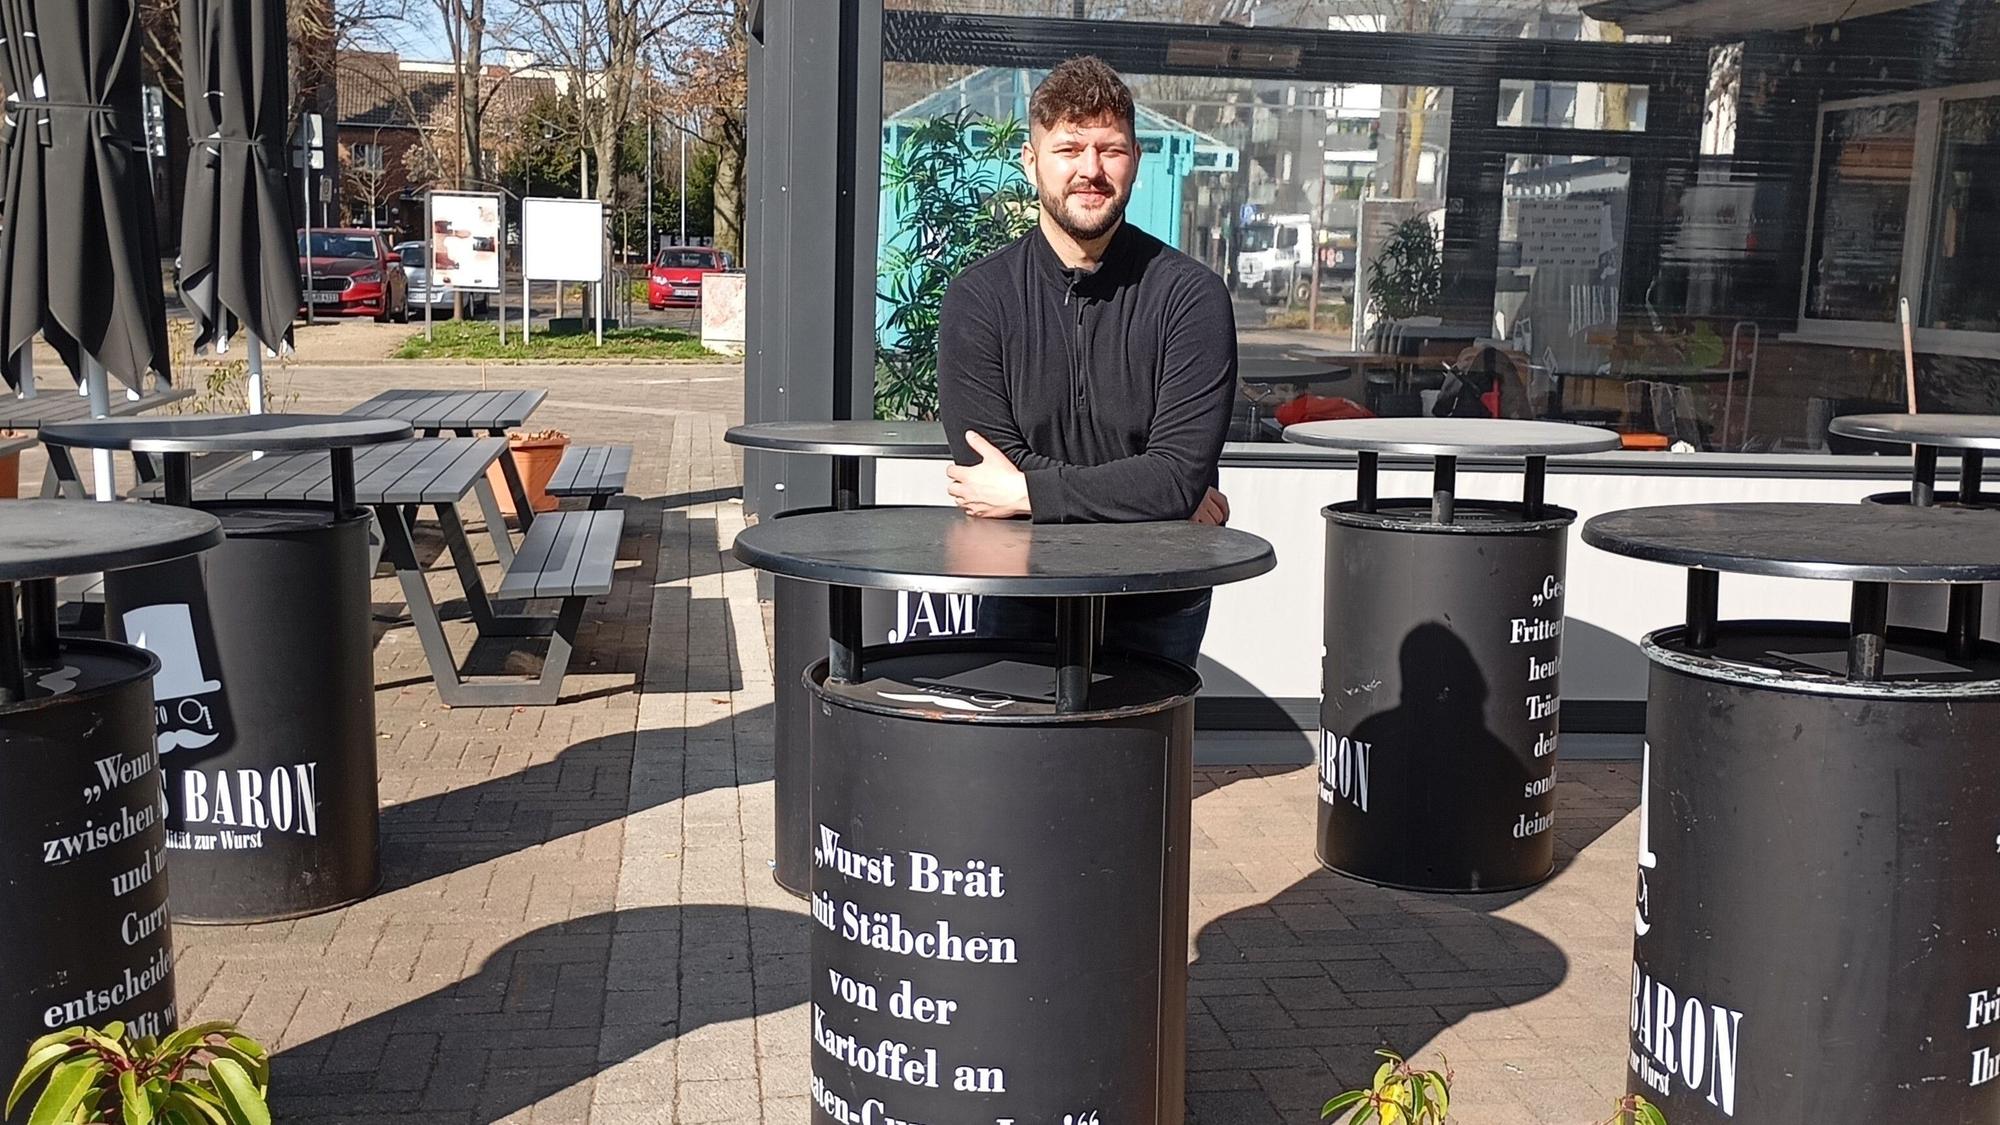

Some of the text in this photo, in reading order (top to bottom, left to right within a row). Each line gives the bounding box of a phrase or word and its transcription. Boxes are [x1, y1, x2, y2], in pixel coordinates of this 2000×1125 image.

[888, 590, 976, 644] JAM
[1526, 694, 1560, 720] Trä
[84, 753, 152, 804] „Wenn
[184, 762, 317, 836] BARON
[44, 805, 154, 863] zwischen
[165, 829, 264, 850] lität zur Wurst
[815, 824, 1005, 898] „Wurst Brät
[111, 849, 152, 897] und
[811, 891, 1018, 964] mit Stäbchen
[828, 968, 958, 1025] von der
[814, 1003, 1006, 1093] Kartoffel an
[1641, 1054, 1669, 1096] Wurst
